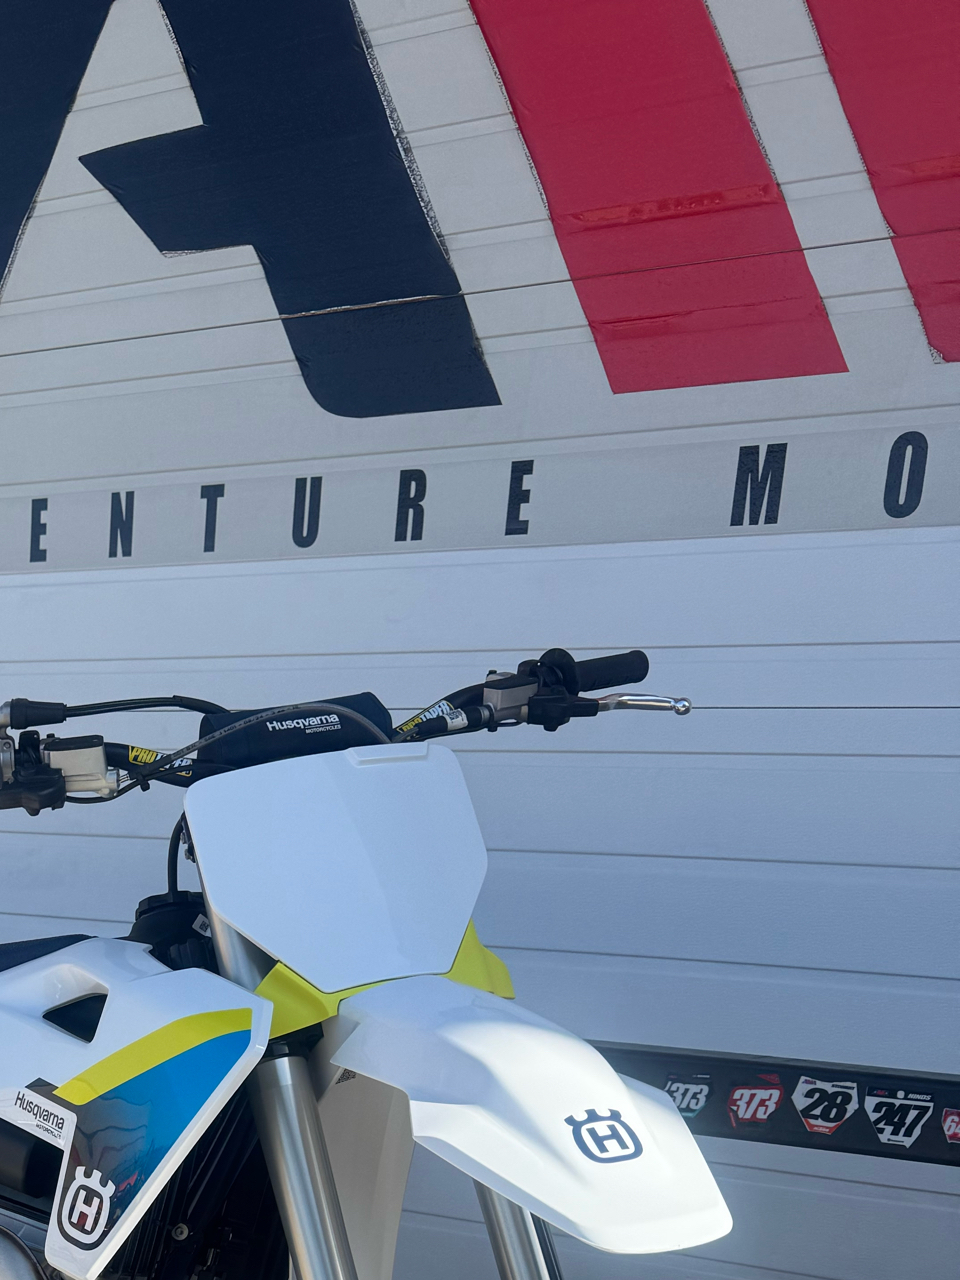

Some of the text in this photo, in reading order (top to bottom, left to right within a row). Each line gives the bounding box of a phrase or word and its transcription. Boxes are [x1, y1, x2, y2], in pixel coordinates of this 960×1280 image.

[730, 431, 929, 526] MO
[266, 713, 340, 731] Husqvarna
[305, 724, 342, 734] MOTORCYCLES
[14, 1091, 65, 1131] Husqvarna
[670, 1082, 709, 1110] 373
[732, 1089, 780, 1119] 373
[800, 1087, 853, 1123] 28
[907, 1093, 932, 1101] HINDS
[872, 1101, 931, 1138] 247
